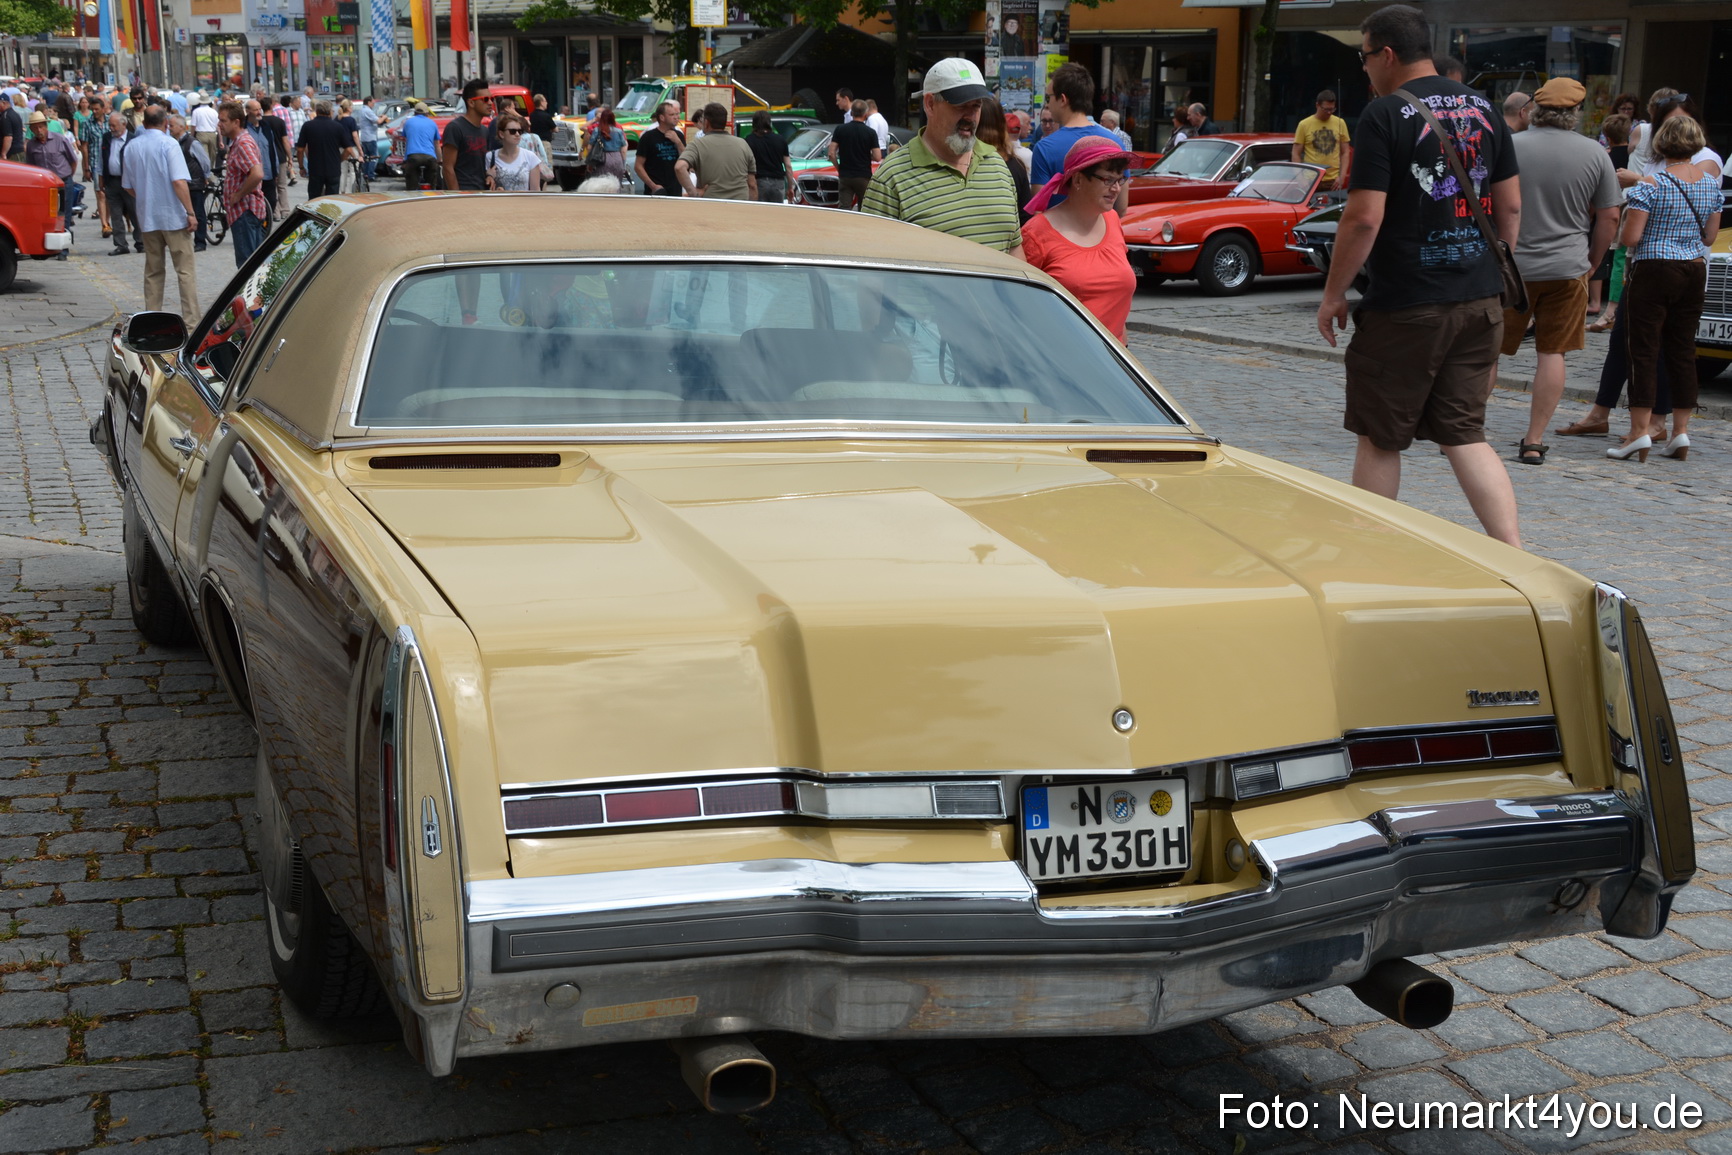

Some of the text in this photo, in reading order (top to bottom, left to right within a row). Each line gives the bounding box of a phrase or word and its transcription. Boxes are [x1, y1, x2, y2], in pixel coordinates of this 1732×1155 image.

[1401, 95, 1443, 119] SUMER
[1078, 786, 1102, 826] N
[1555, 802, 1592, 812] Amoco
[1032, 814, 1042, 827] D
